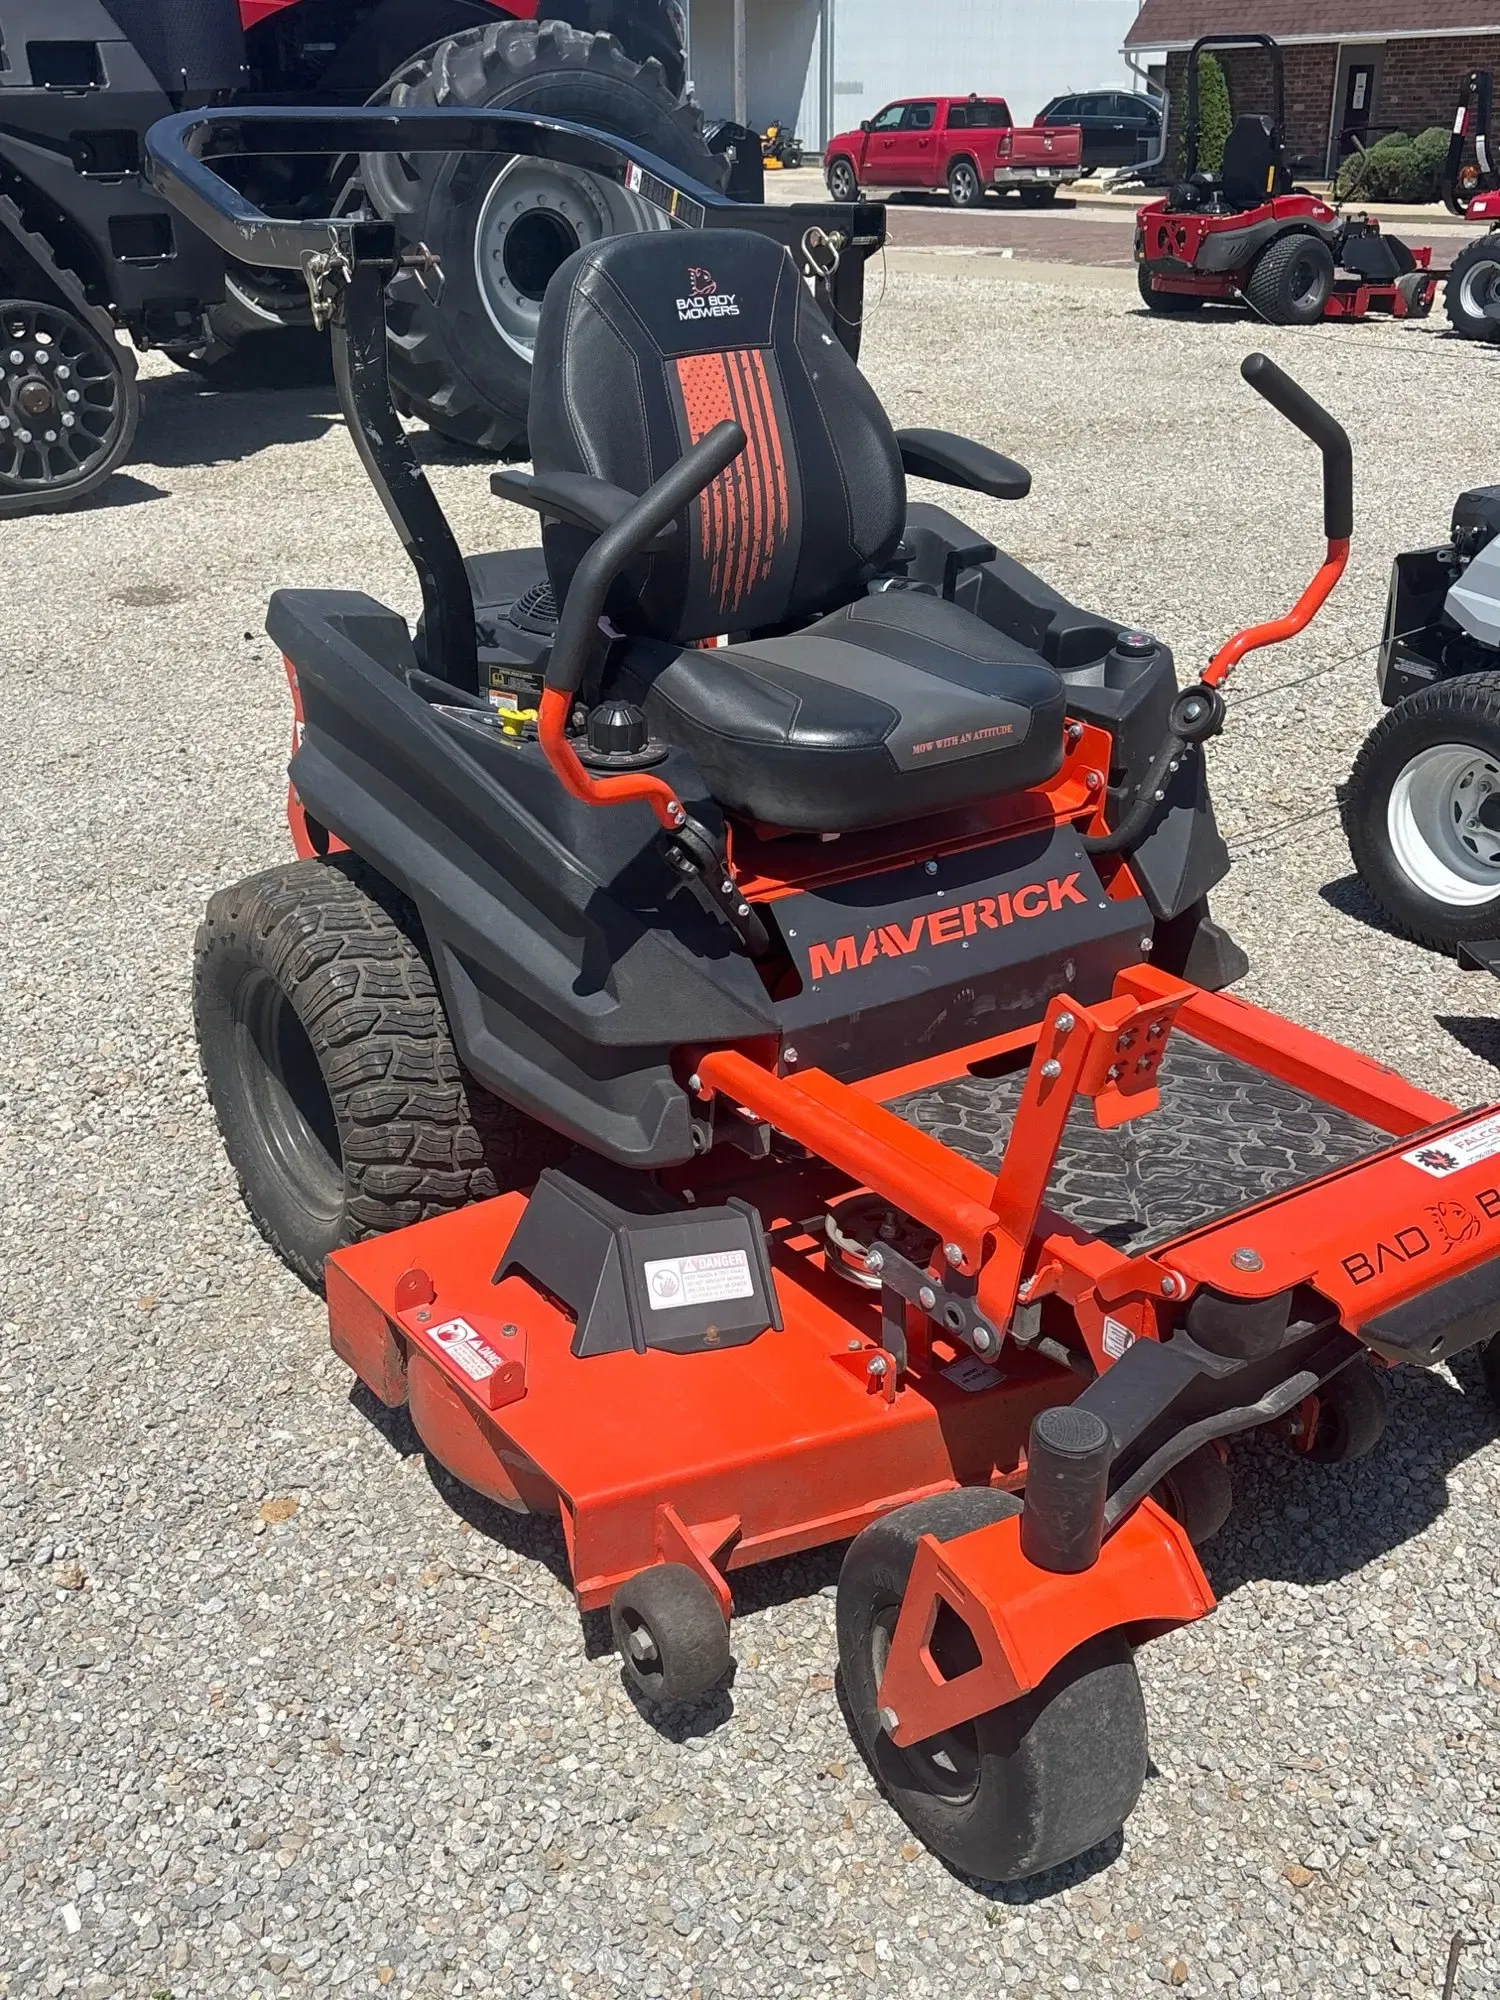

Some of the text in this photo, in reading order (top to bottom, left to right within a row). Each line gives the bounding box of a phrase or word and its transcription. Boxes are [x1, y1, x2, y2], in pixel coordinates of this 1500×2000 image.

[676, 294, 736, 310] BAD BOY
[678, 305, 740, 321] MOWERS
[912, 724, 1014, 755] MOW WITH AN ATTITUDE
[808, 872, 1089, 980] MAVERICK
[699, 1255, 744, 1270] DANGER
[1341, 1226, 1431, 1285] BAD
